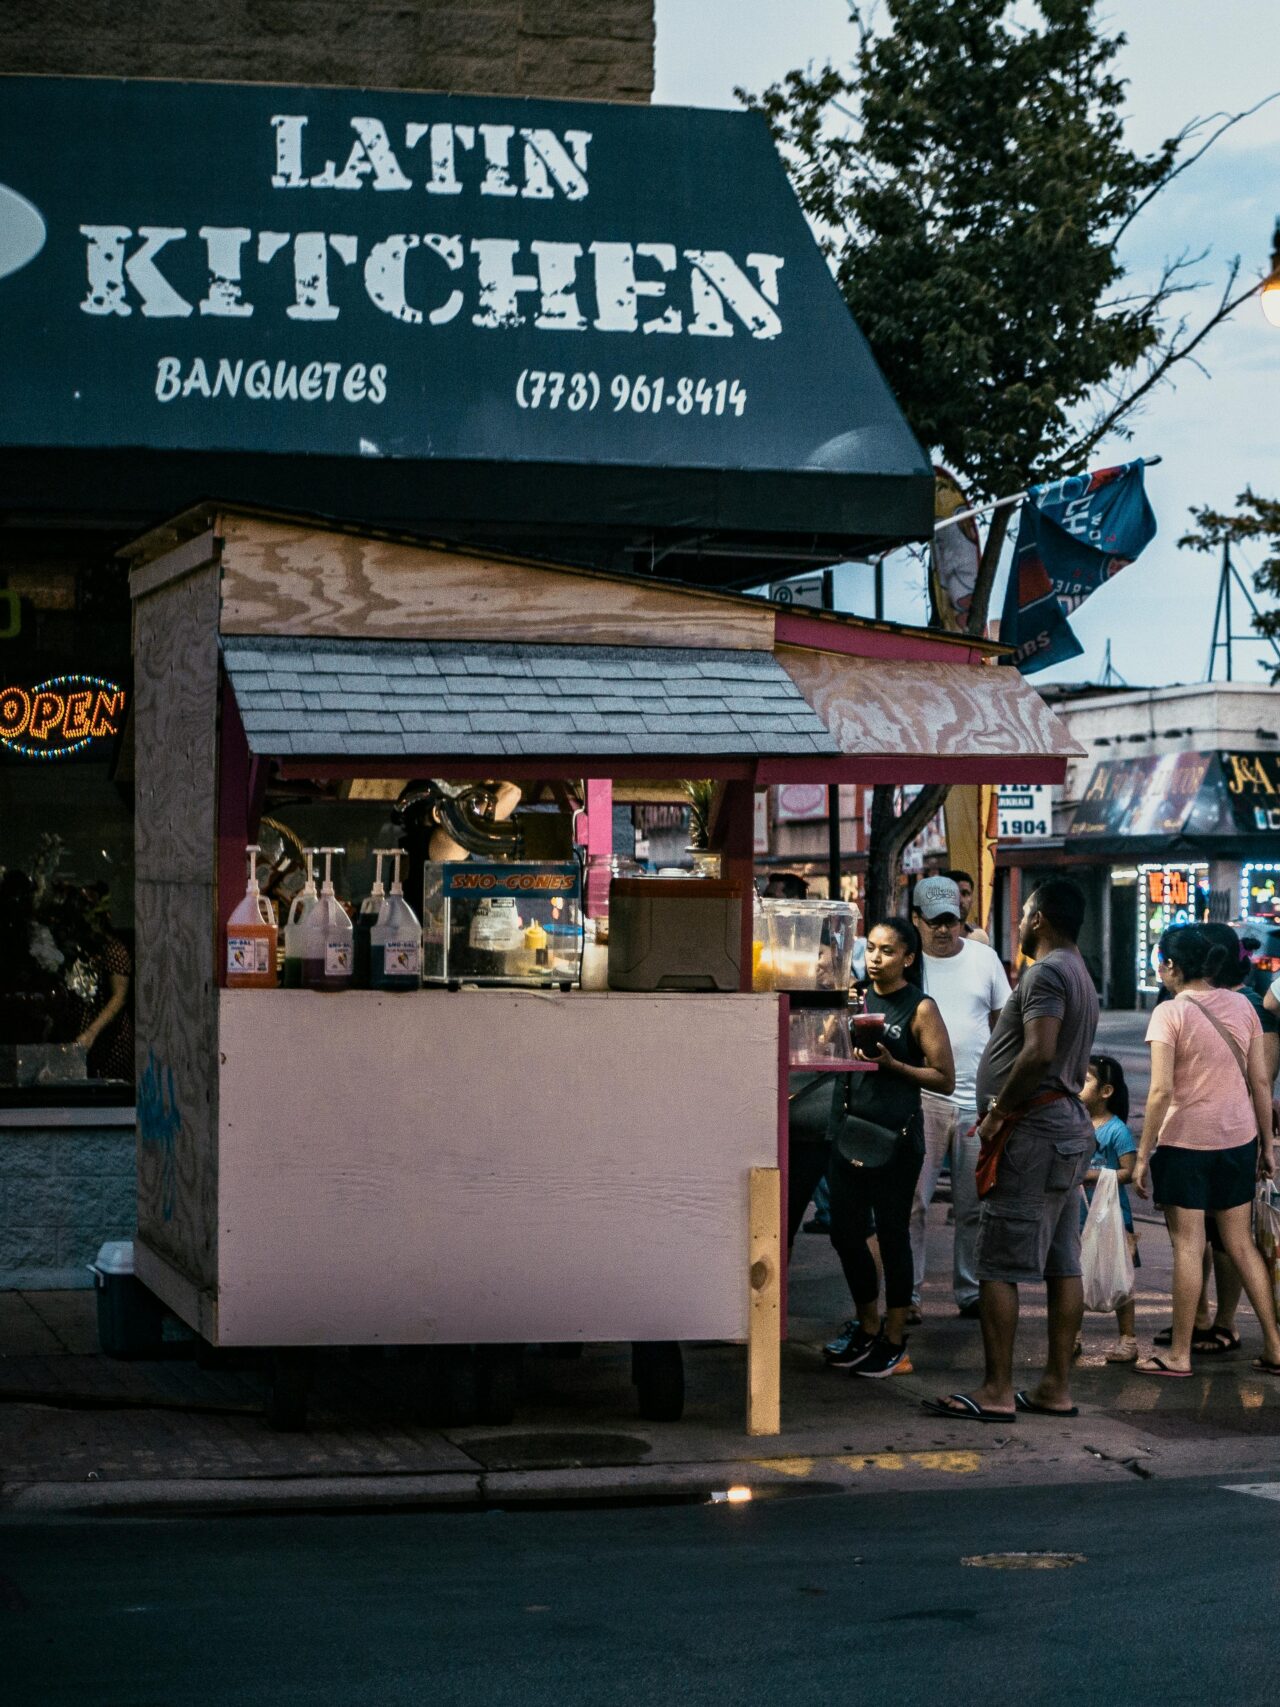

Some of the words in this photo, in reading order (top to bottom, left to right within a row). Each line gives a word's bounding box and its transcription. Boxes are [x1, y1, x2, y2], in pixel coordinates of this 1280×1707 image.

[271, 115, 593, 201] LATIN
[79, 224, 785, 340] KITCHEN
[155, 356, 388, 405] BANQUETES
[515, 369, 601, 412] (773)
[610, 372, 748, 418] 961-8414
[1012, 630, 1051, 666] UBS
[0, 688, 125, 739] OPEN
[1001, 820, 1047, 835] 1904
[451, 872, 577, 890] SNO-CONES
